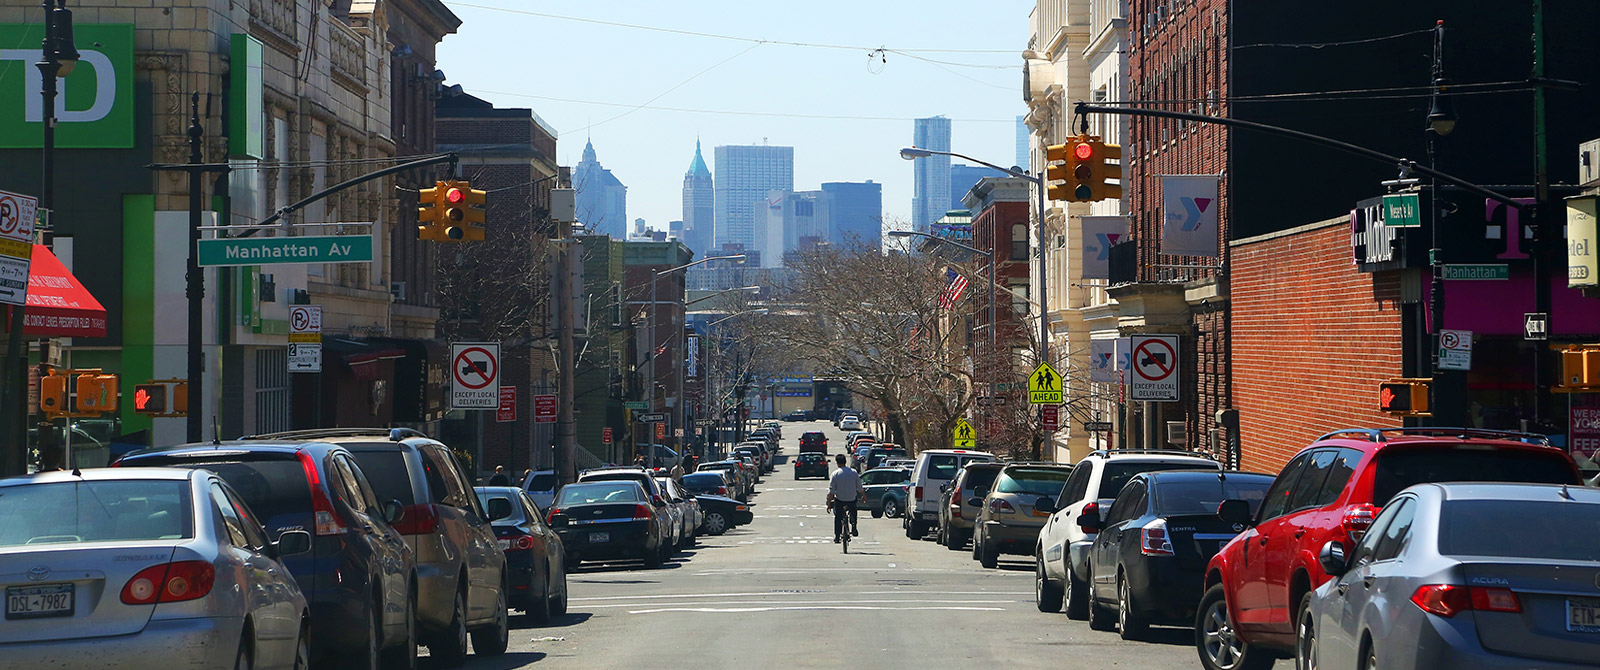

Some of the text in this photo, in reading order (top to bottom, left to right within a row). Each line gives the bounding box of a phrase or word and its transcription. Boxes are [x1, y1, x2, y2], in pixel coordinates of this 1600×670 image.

[0, 49, 116, 122] TD
[1166, 211, 1182, 220] the
[225, 242, 352, 259] Manhattan Av
[1445, 266, 1497, 278] Manhattan
[1033, 393, 1059, 401] AHEAD
[1472, 577, 1510, 585] ACURA
[11, 593, 67, 612] DSL 7982
[1573, 607, 1595, 625] ETN
